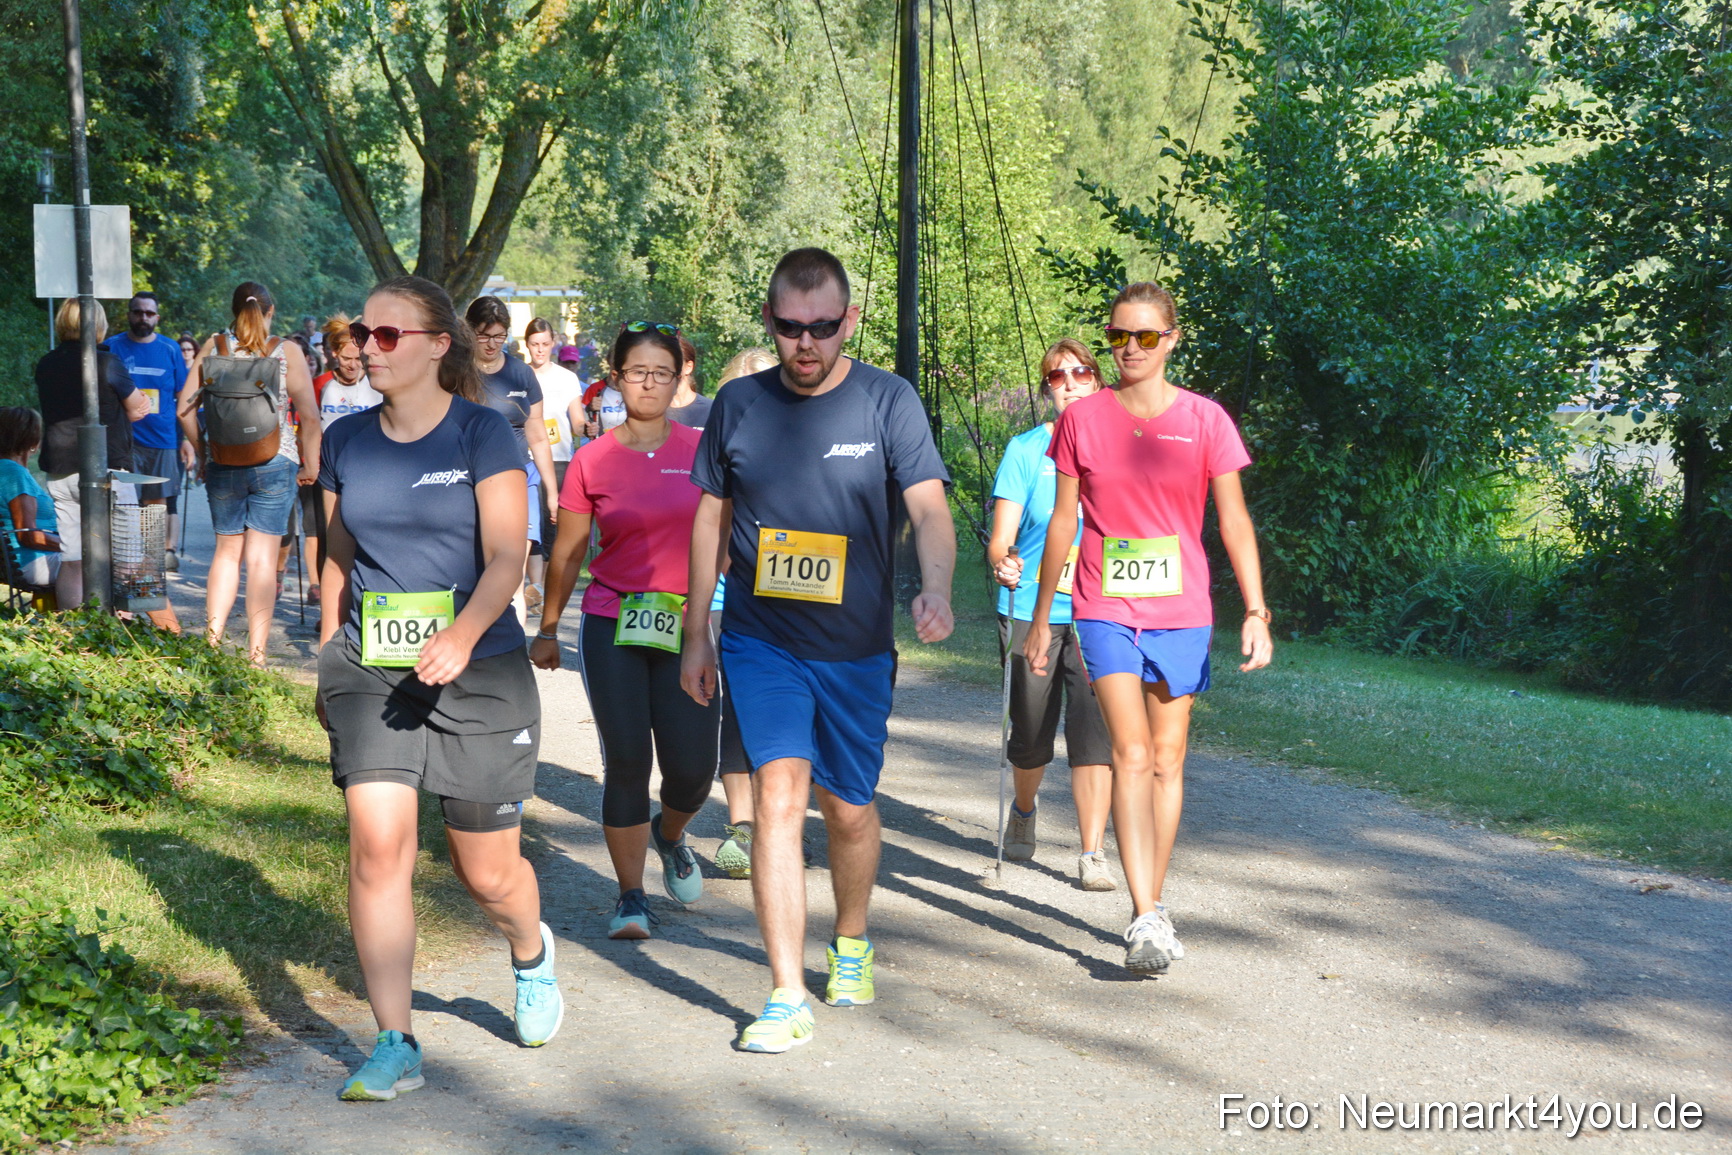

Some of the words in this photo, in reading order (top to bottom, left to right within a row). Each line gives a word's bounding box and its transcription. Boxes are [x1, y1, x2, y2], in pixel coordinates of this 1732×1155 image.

[767, 553, 831, 582] 1100
[1112, 558, 1168, 581] 2071
[769, 578, 789, 586] Tomm
[790, 580, 826, 590] Alexander
[373, 618, 439, 645] 1084
[624, 609, 676, 636] 2062
